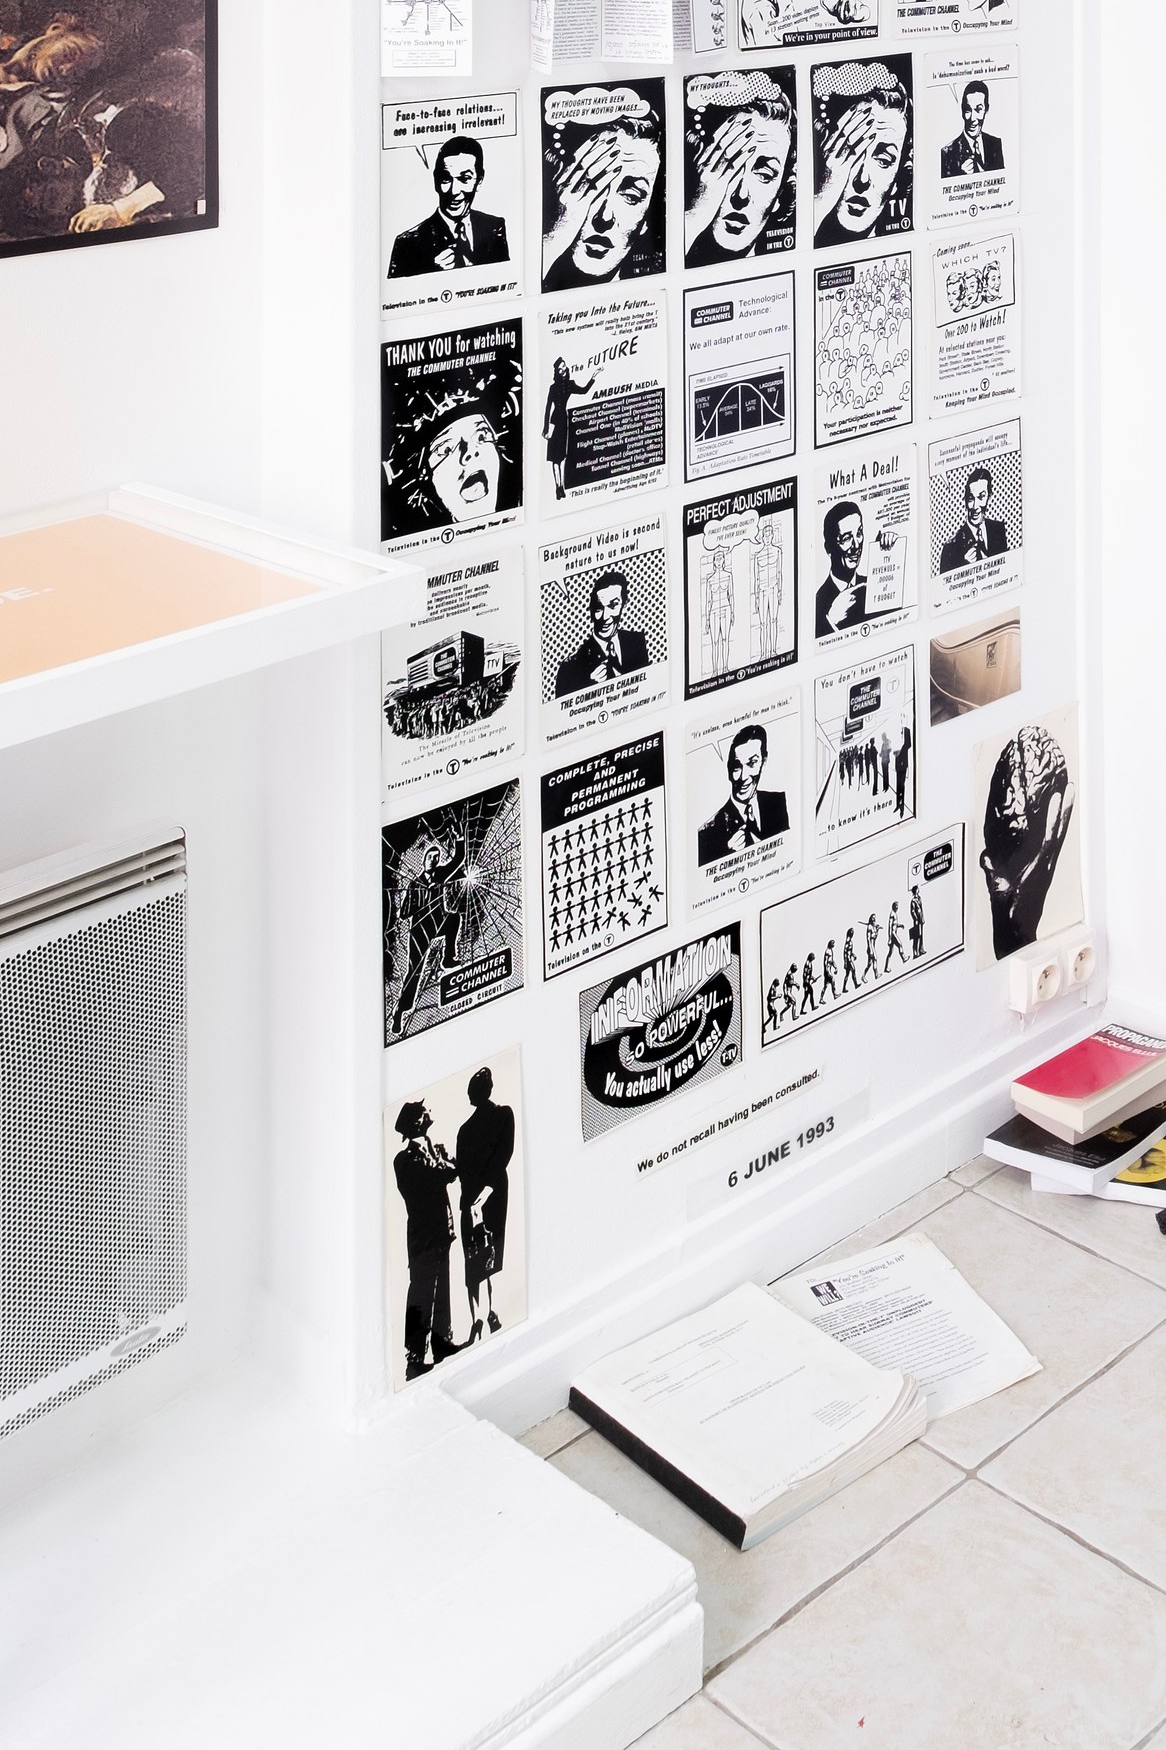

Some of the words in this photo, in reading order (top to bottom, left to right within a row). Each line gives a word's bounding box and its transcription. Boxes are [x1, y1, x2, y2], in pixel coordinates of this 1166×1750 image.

[785, 32, 805, 42] We're
[806, 32, 813, 41] in
[815, 32, 830, 41] your
[832, 30, 850, 40] point
[852, 28, 859, 36] of
[860, 28, 878, 36] view.
[551, 102, 559, 110] MY
[562, 98, 592, 108] THOUGHTS
[593, 96, 608, 104] HAVE
[610, 95, 625, 103] BEEN
[552, 108, 580, 120] REPLACED
[582, 108, 589, 116] BY
[591, 106, 614, 115] MOVING
[739, 291, 788, 307] Technological
[739, 306, 771, 318] Advance:
[386, 341, 425, 366] THANK
[429, 336, 451, 358] YOU
[456, 335, 470, 353] for
[474, 328, 515, 348] watching
[587, 336, 639, 368] FUTURE
[689, 342, 701, 350] We
[703, 338, 712, 347] all
[714, 335, 734, 346] adapt
[744, 330, 756, 338] our
[758, 327, 773, 336] own
[775, 323, 790, 333] rate.
[408, 366, 421, 377] THE
[423, 358, 464, 374] COMMUTER
[466, 351, 496, 366] CHANNEL
[592, 384, 632, 400] AMBUSH
[635, 379, 658, 391] MEDIA
[830, 469, 855, 489] What
[860, 464, 867, 481] A
[873, 456, 899, 477] Deal!
[687, 500, 731, 525] PERFECT
[733, 483, 793, 512] ADJUSTMENT
[544, 537, 592, 562] Background
[596, 532, 619, 546] Video
[622, 528, 629, 539] is
[633, 518, 660, 536] second
[565, 556, 592, 570] nature
[596, 552, 604, 561] to
[608, 550, 616, 558] us
[621, 539, 639, 554] now!
[549, 757, 610, 787] COMPLETE,
[614, 738, 659, 761] PRECISE
[594, 766, 616, 781] AND
[564, 778, 646, 816] PROGRAMMING
[572, 769, 639, 802] PERMANENT
[450, 955, 505, 985] COMMUTER
[462, 966, 507, 991] CHANNEL
[591, 934, 731, 1045] INFORMATION
[626, 1042, 644, 1066] SO
[650, 990, 732, 1048] POWERFUL...
[605, 1072, 622, 1098] You
[626, 1065, 671, 1097] actually
[675, 1056, 695, 1078] use
[696, 1020, 722, 1060] less!
[637, 1158, 653, 1173] We
[657, 1151, 669, 1164] do
[672, 1140, 687, 1156] not
[690, 1123, 715, 1145] recall
[718, 1108, 749, 1131] having
[751, 1096, 773, 1113] been
[776, 1069, 820, 1099] consulted.
[728, 1171, 738, 1188] 6
[744, 1141, 790, 1180] JUNE
[797, 1116, 835, 1150] 1993
